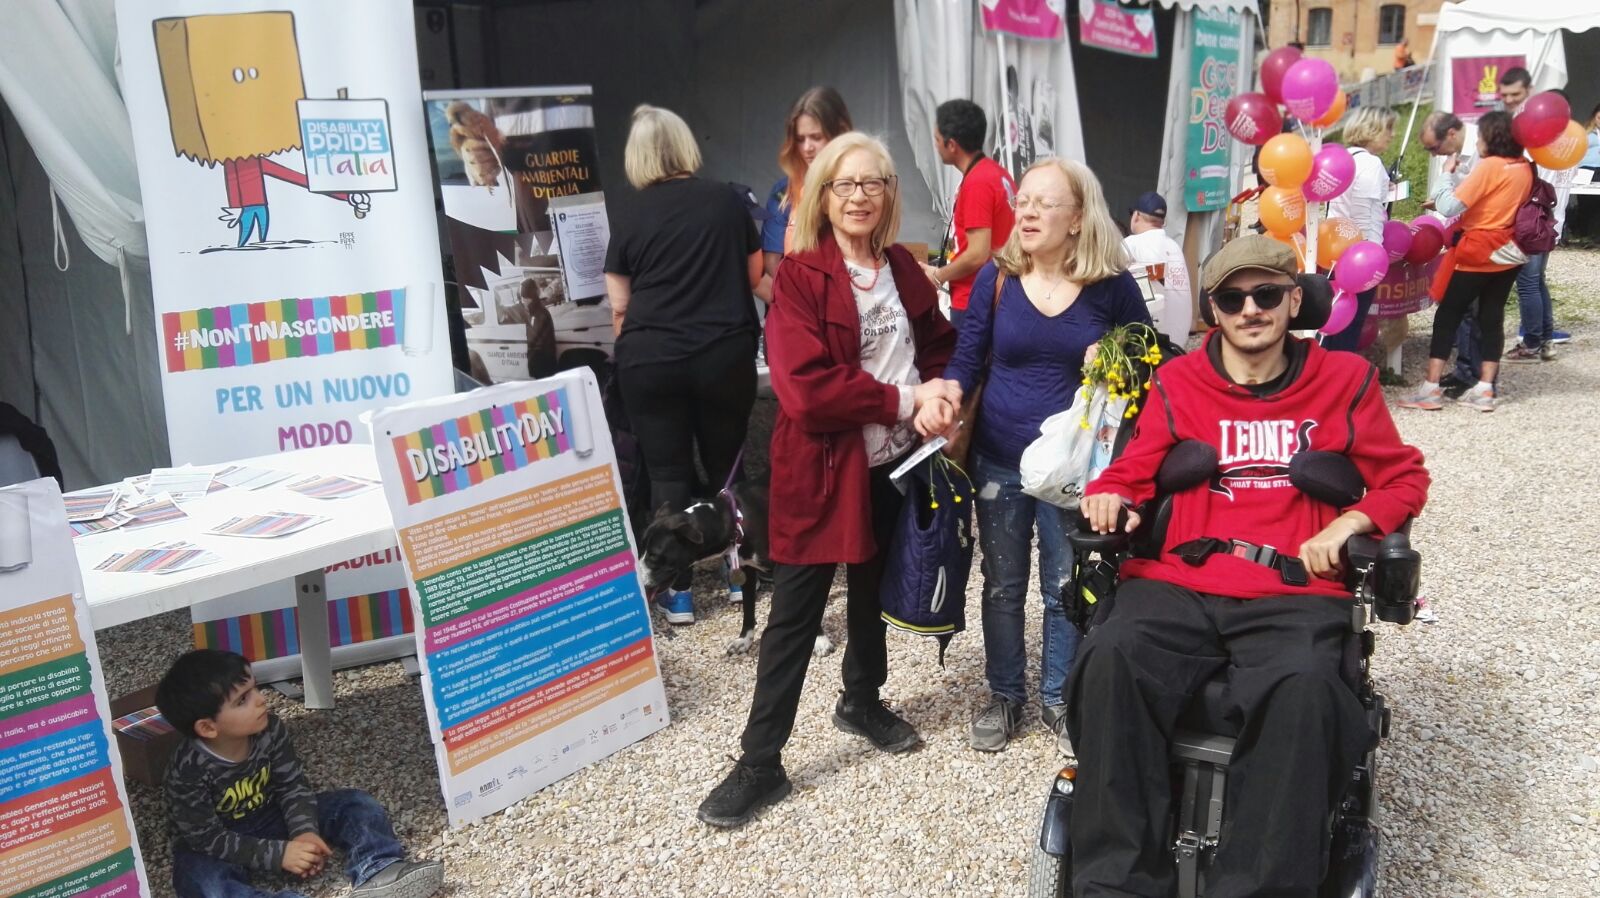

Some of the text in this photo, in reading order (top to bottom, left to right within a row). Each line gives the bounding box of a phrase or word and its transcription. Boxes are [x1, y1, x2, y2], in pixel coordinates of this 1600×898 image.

[306, 122, 380, 133] DISABILITY
[308, 132, 382, 151] PRIDE
[525, 149, 580, 168] GUARDIE
[522, 167, 588, 185] AMBIENTALI
[533, 186, 580, 200] D'ITALIA
[216, 372, 411, 414] PER UN NUOVO
[278, 420, 353, 452] MODO
[406, 407, 565, 482] DISABILITYDAY
[1218, 420, 1294, 465] LEONE
[1230, 480, 1294, 488] MUAY THAI STYL
[508, 556, 522, 564] legge
[422, 575, 445, 585] Tenendo
[446, 569, 461, 578] conto
[478, 558, 493, 567] legge
[484, 572, 496, 580] delle
[10, 616, 33, 625] indica
[42, 607, 65, 617] strada
[14, 623, 40, 634] sociale
[51, 616, 67, 624] tutti
[45, 624, 69, 635] mondo
[20, 641, 39, 650] leggi
[7, 678, 36, 695] portare
[47, 666, 79, 679] disabilità
[22, 685, 46, 695] diritto
[56, 675, 80, 686] essere
[25, 693, 49, 704] stesse
[51, 685, 81, 696] opportu-
[48, 708, 87, 724] auspicabile
[18, 748, 42, 758] fermo
[43, 738, 76, 751] restando
[50, 750, 64, 758] che
[28, 764, 51, 775] quelle
[52, 754, 84, 767] adottate
[24, 797, 58, 812] Generale
[60, 791, 77, 800] delle
[79, 781, 104, 794] Nazioni
[10, 816, 30, 826] dopo
[71, 793, 97, 806] entrata
[30, 821, 39, 829] 18
[41, 816, 54, 825] del
[56, 806, 86, 820] febbraio
[64, 875, 88, 887] favore
[89, 868, 106, 878] delle
